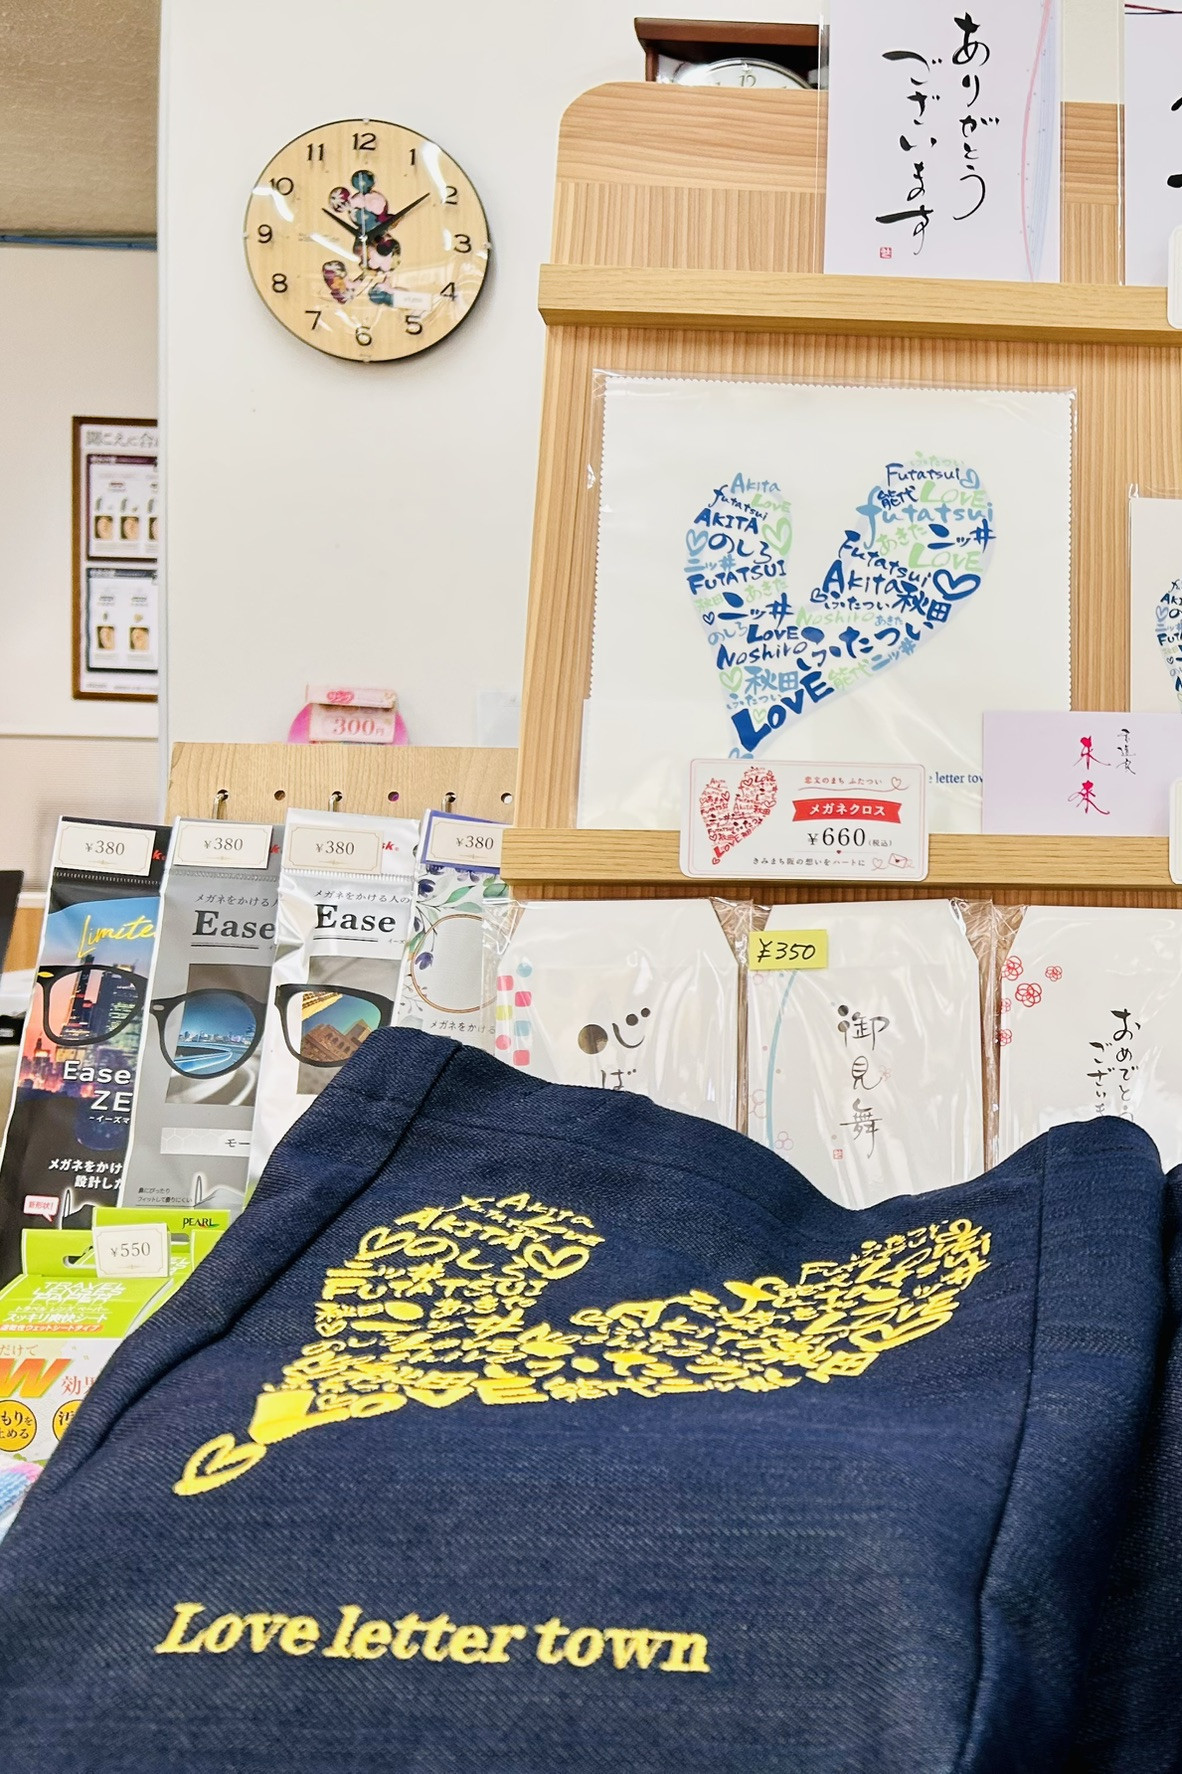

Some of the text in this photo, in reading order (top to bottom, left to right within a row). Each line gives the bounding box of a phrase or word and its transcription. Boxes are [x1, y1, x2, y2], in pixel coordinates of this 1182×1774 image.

[952, 11, 1000, 221] ありがとう
[352, 133, 376, 150] 12
[307, 144, 324, 161] 11
[409, 149, 416, 165] 1
[875, 49, 943, 256] ございます
[270, 177, 294, 195] 10
[443, 186, 458, 205] 2
[258, 224, 273, 243] 9
[455, 234, 471, 253] 3
[272, 273, 288, 293] 8
[440, 282, 456, 300] 4
[305, 311, 321, 330] 7
[405, 316, 422, 335] 5
[356, 327, 372, 346] 6
[731, 472, 781, 493] Akita
[885, 463, 960, 486] Futatsui
[694, 508, 758, 534] AKITA
[708, 533, 772, 564] のしろ
[687, 559, 786, 595] FUTATSUI
[823, 560, 905, 594] Akita
[892, 580, 952, 623] 秋田
[747, 624, 799, 643] LOVE
[717, 641, 807, 670] Noshiro
[744, 666, 799, 694] 秋田
[732, 671, 834, 751] LOVE
[936, 771, 965, 783] letter
[809, 803, 886, 816] メガネクロス
[204, 838, 244, 851] ¥380
[455, 837, 494, 850] ¥380
[808, 828, 892, 847] ¥660 (税込)
[85, 840, 125, 856] ¥380
[316, 841, 355, 855] ¥380
[313, 889, 410, 903] メガネをかける人の
[192, 910, 275, 939] Ease
[314, 904, 396, 933] Ease
[77, 915, 156, 959] Limite
[757, 938, 816, 963] ¥350
[63, 1060, 131, 1085] Ease
[1110, 1008, 1141, 1122] おめでとう
[837, 1004, 890, 1159] 御見舞
[182, 1217, 214, 1229] PEARL
[111, 1242, 151, 1258] ¥550
[154, 1603, 710, 1672] Love letter town
